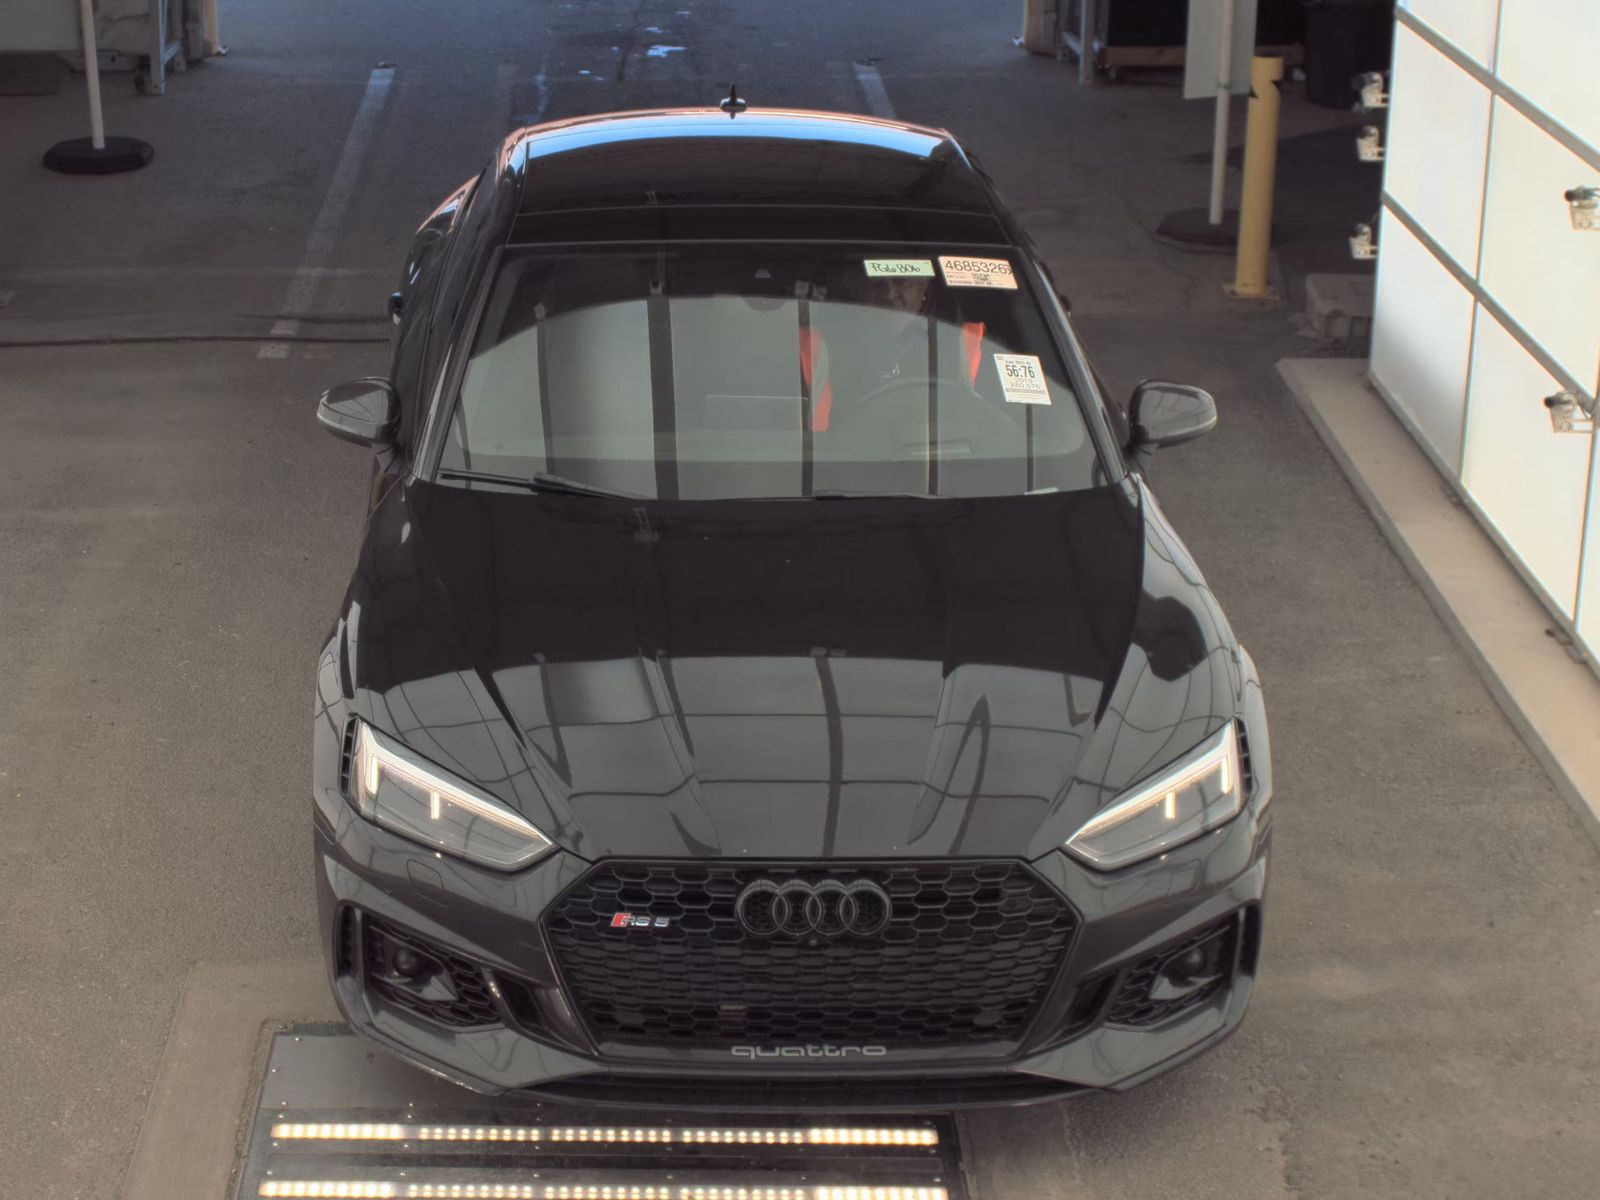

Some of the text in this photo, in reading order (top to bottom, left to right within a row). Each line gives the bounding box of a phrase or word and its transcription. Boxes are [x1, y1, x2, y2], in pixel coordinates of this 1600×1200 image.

[1005, 364, 1035, 379] 56:76
[614, 913, 670, 927] RS 5
[731, 1045, 887, 1059] quattro
